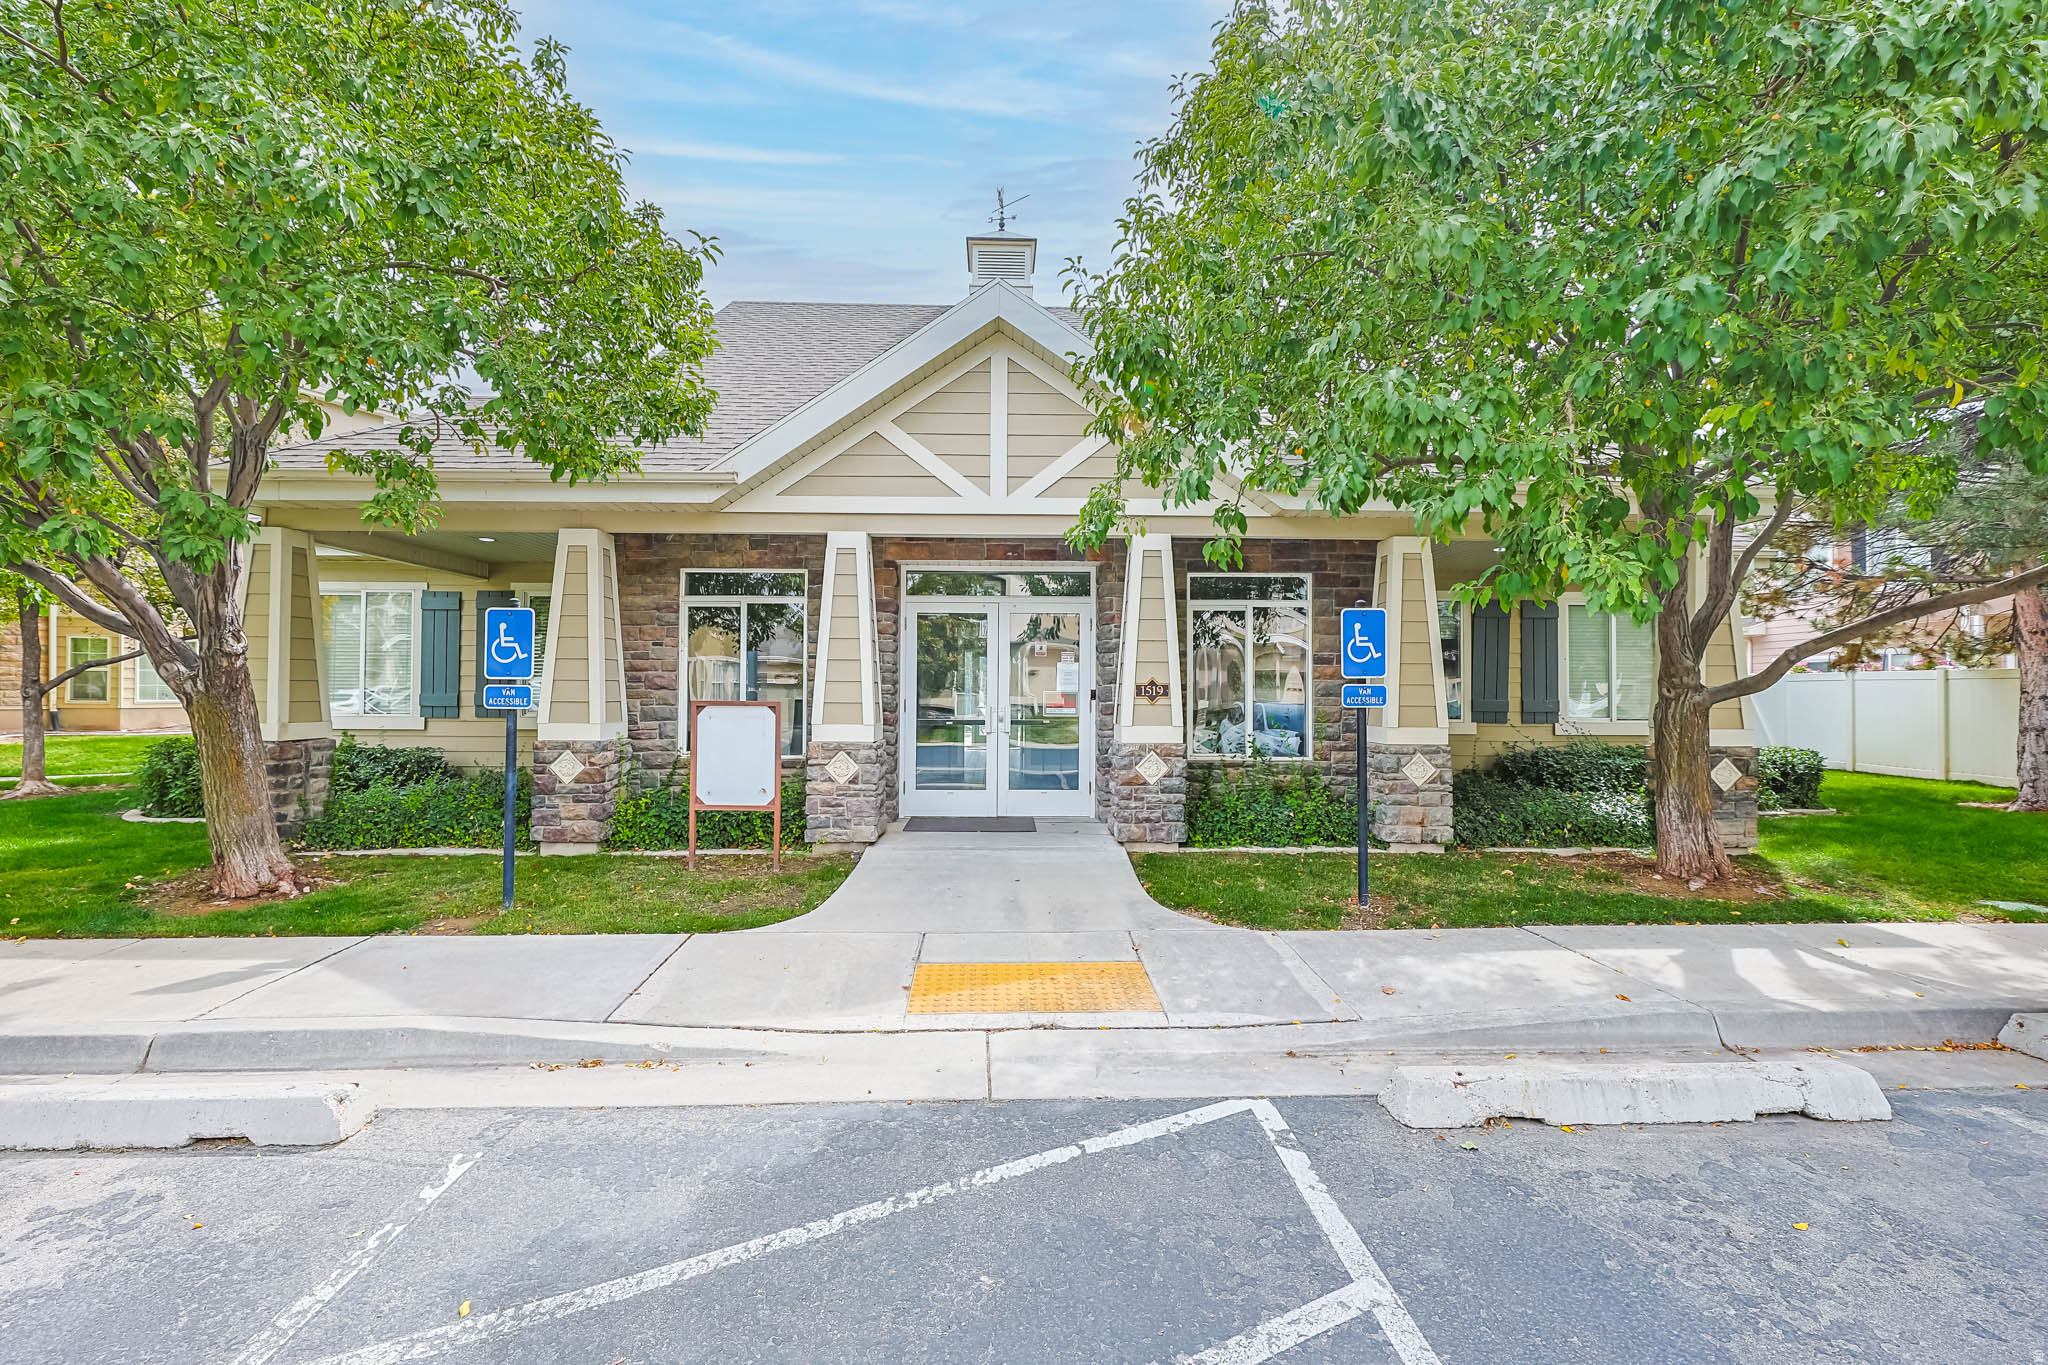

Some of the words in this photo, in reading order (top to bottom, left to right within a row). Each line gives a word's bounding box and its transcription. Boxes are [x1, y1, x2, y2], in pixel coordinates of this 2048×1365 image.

[501, 688, 516, 696] VAN
[1140, 685, 1164, 696] 1519
[1358, 687, 1371, 695] VAN
[488, 697, 528, 706] ACCESSIBLE
[1346, 696, 1384, 704] ACCESSIBLE
